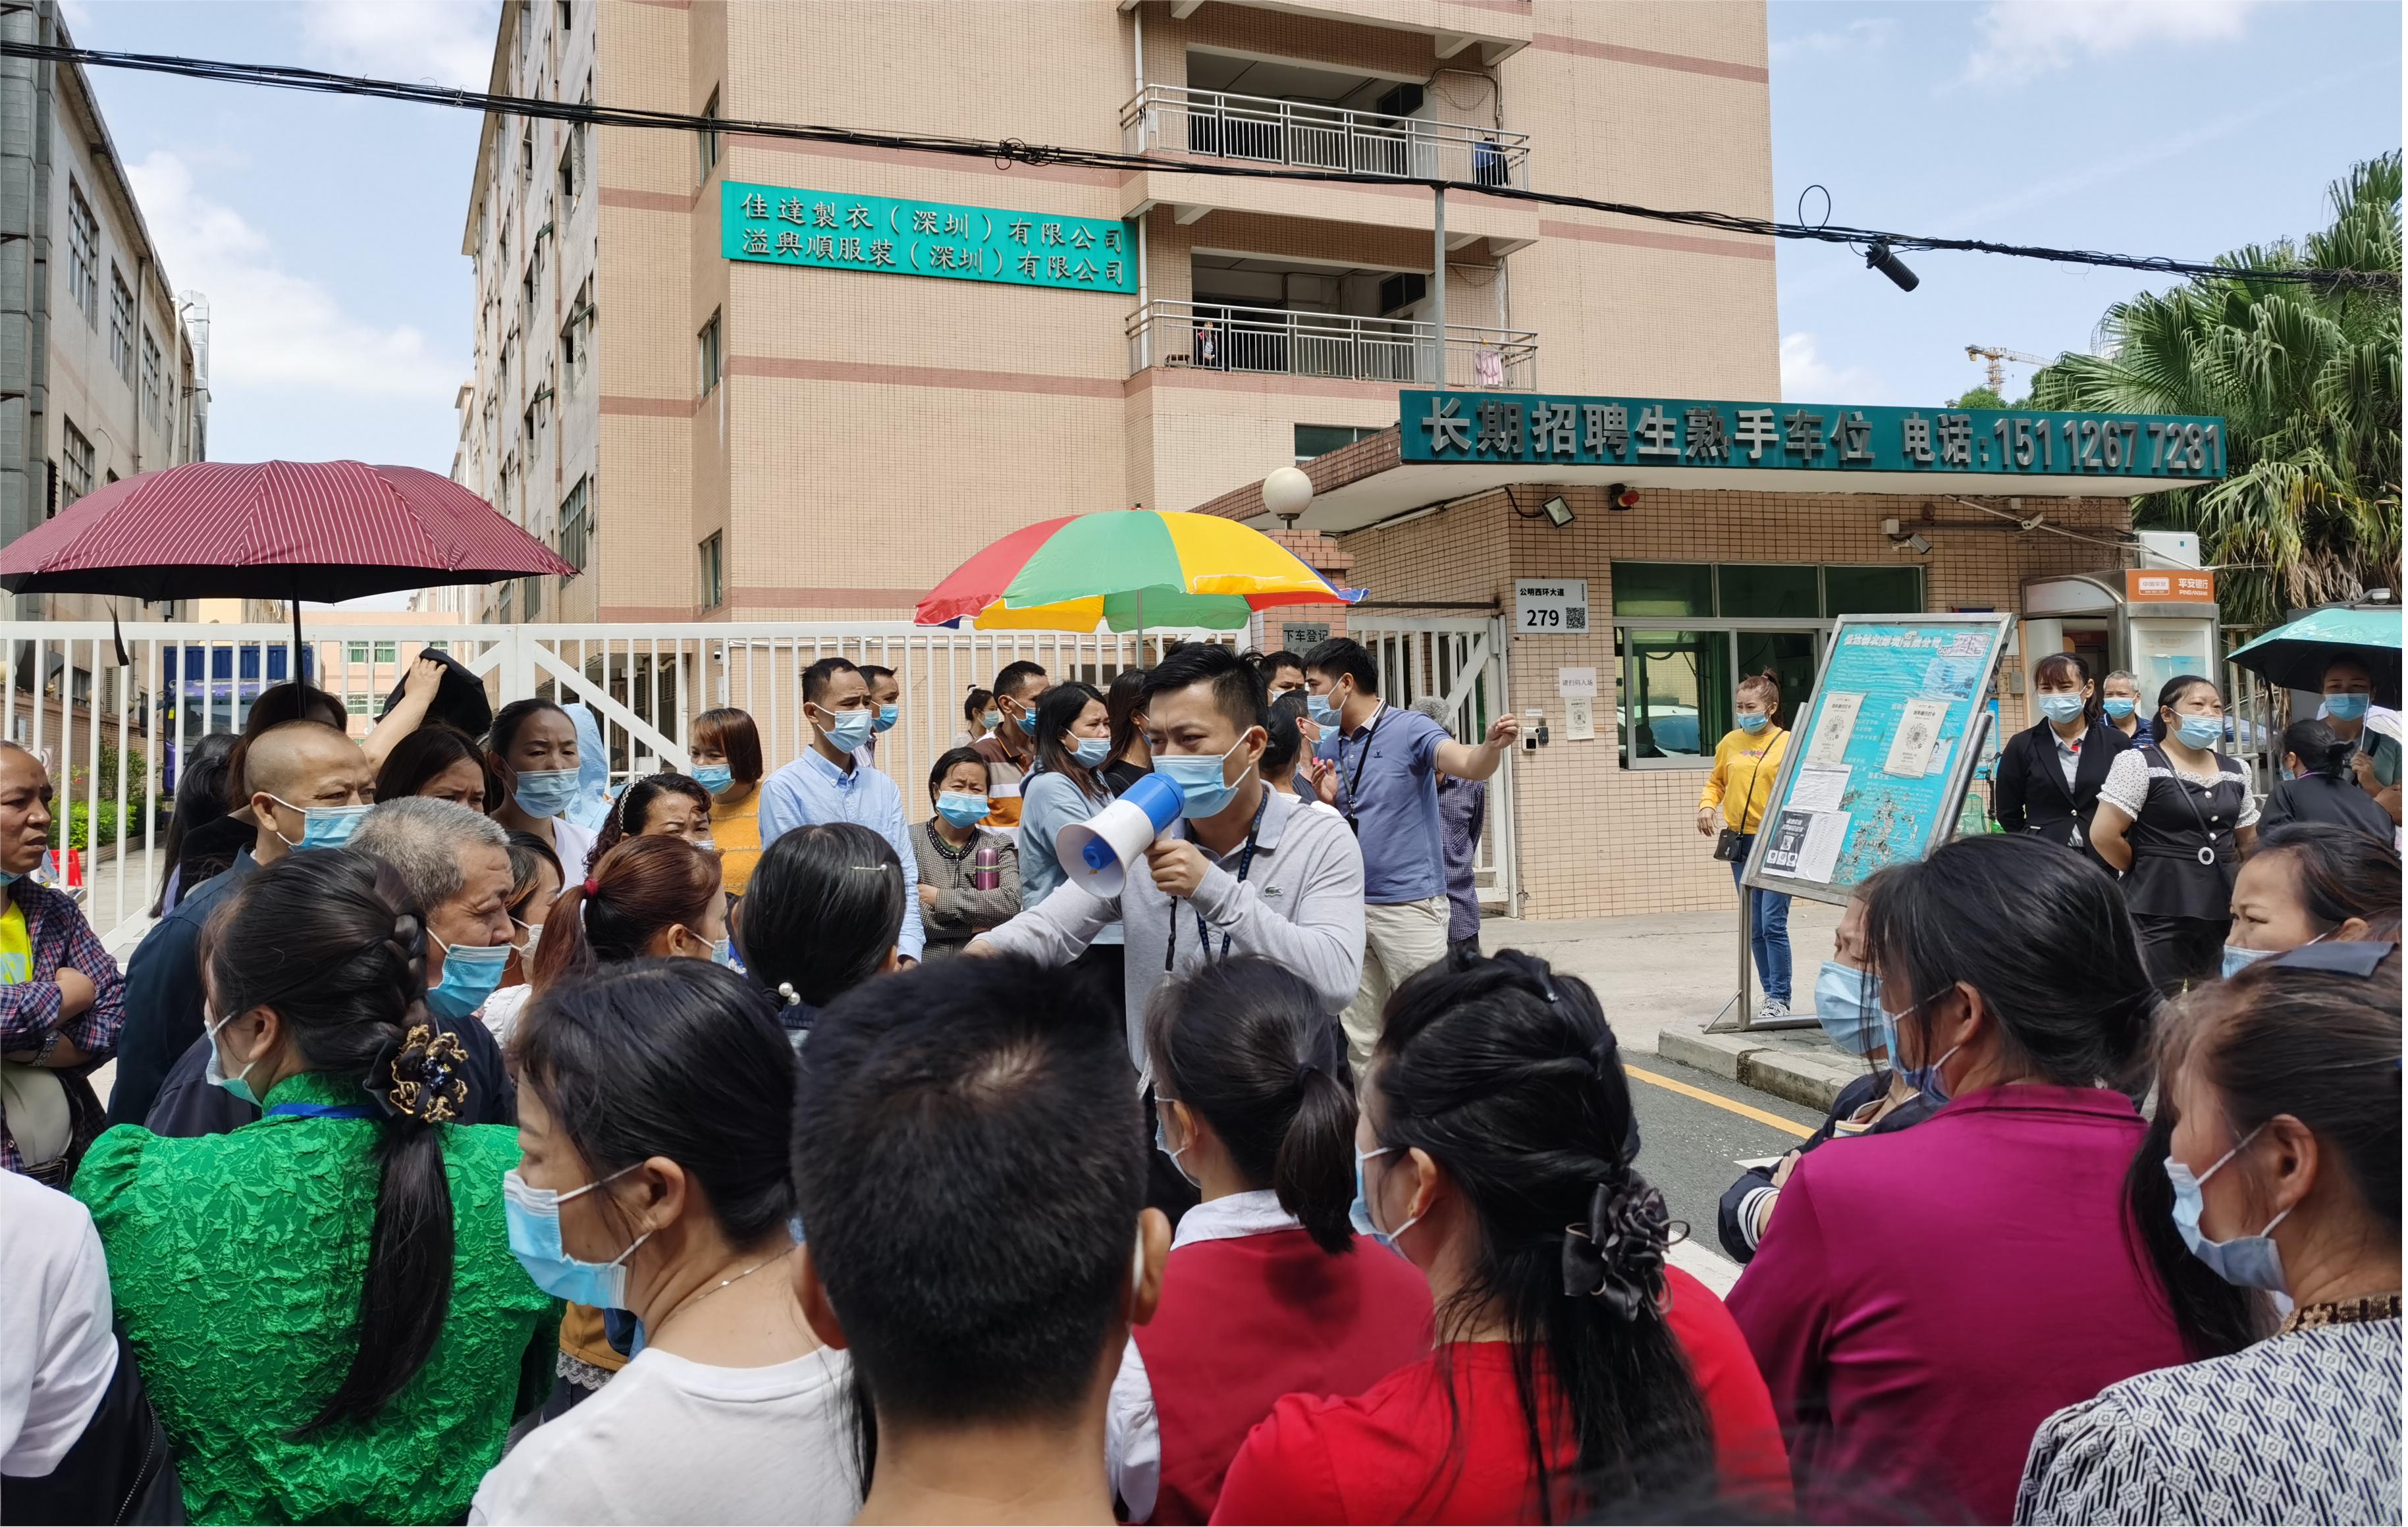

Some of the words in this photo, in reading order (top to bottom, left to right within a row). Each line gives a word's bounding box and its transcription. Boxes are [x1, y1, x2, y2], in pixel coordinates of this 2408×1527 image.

[741, 192, 1122, 254] 佳達製衣（深圳）有限公司
[741, 228, 1123, 286] 溢興順服裝（深圳）有限公司
[1421, 396, 1876, 461] 长期招聘生熟手车位
[2063, 419, 2139, 468] 1267
[2147, 422, 2220, 470] 7281
[2178, 578, 2208, 589] 平安银行
[1520, 588, 1565, 597] 公明西环大道
[1526, 609, 1559, 626] 279
[1283, 629, 1328, 643] 下车登记
